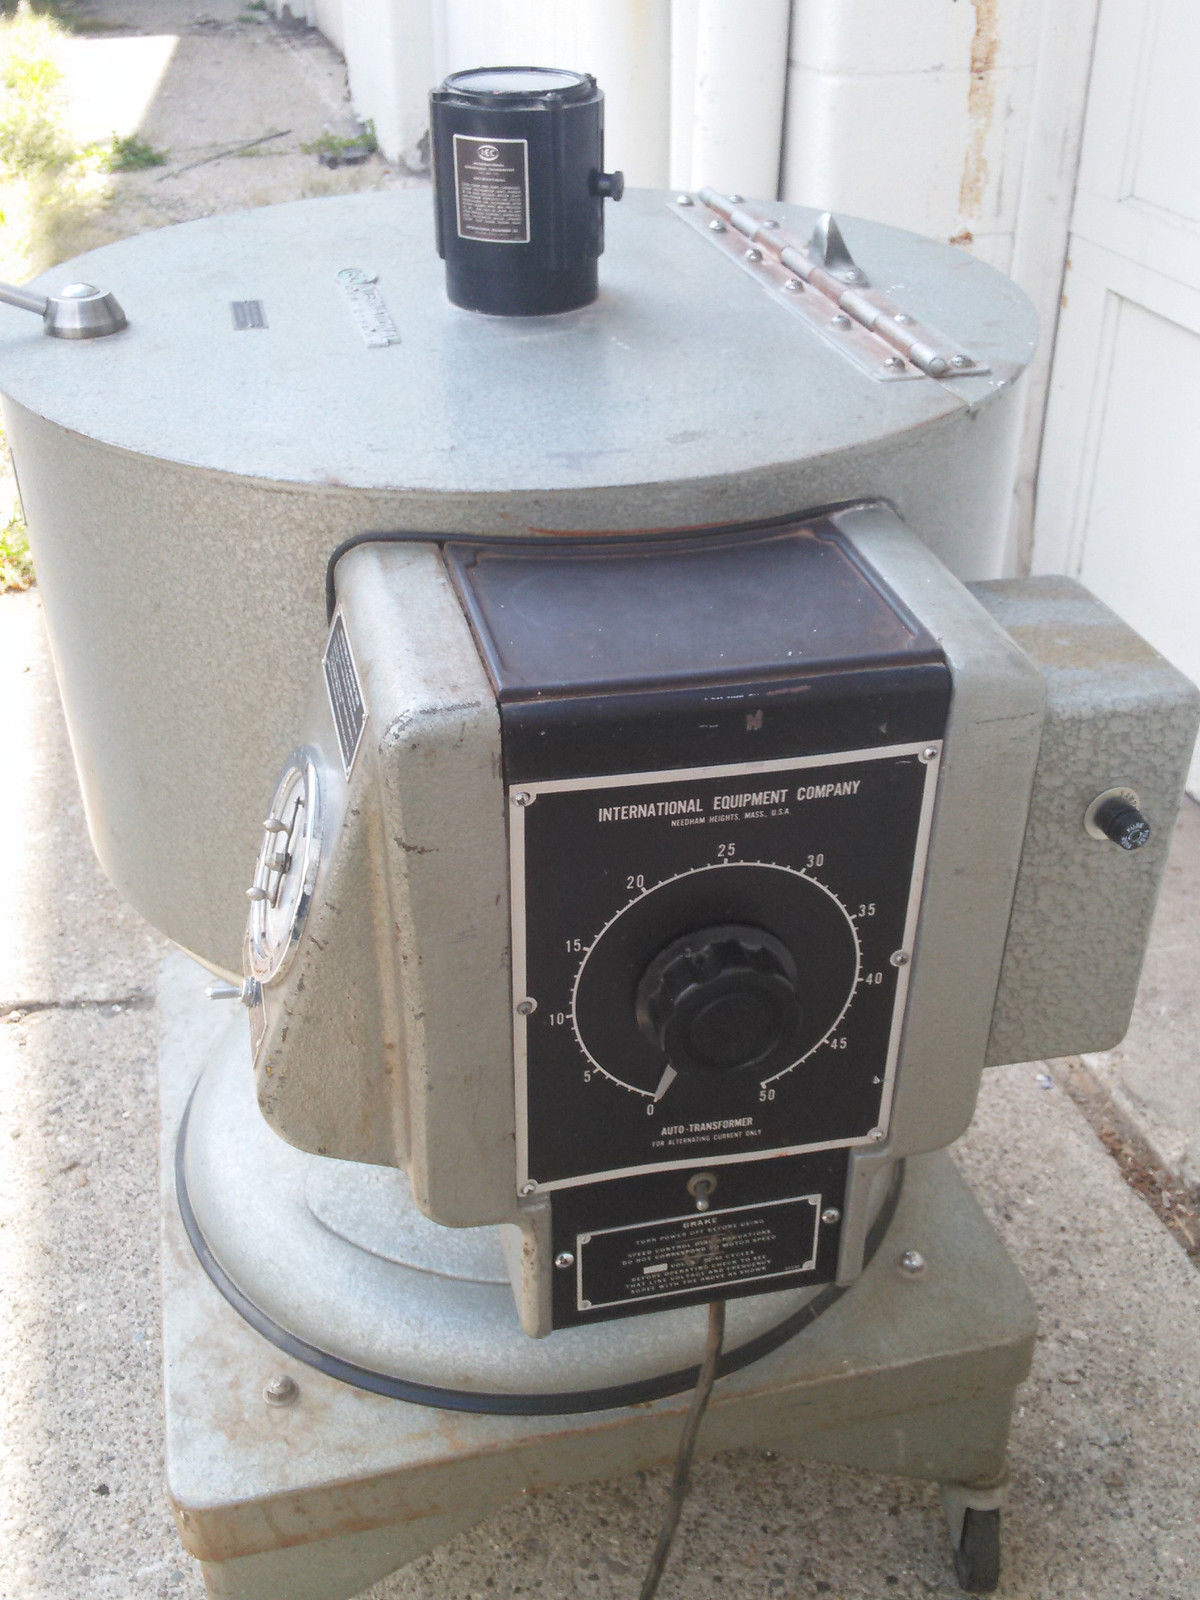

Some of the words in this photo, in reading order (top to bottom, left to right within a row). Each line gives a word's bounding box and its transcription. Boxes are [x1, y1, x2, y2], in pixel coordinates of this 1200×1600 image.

[598, 799, 703, 822] INTERNATIONAL
[713, 789, 788, 810] EQUIPMENT
[796, 780, 861, 801] COMPANY
[671, 817, 706, 827] NEEDHAM
[717, 843, 736, 856] 25
[806, 854, 824, 867] 30
[627, 875, 644, 888] 20
[858, 903, 876, 916] 35
[566, 939, 582, 952] 15
[865, 972, 883, 985] 40
[550, 1013, 564, 1025] 10
[830, 1037, 847, 1049] 45
[584, 1071, 591, 1082] 5
[759, 1089, 775, 1102] 50
[646, 1104, 654, 1116] 0
[661, 1117, 753, 1136] AUTO-TRANSFORMER
[668, 1135, 711, 1145] ALTERNATING
[713, 1131, 742, 1140] CURRENT
[745, 1129, 761, 1137] ONLY
[683, 1218, 718, 1229] BRAKE
[636, 1238, 657, 1246] TURN
[660, 1231, 687, 1241] POWER
[690, 1228, 704, 1236] OFF
[707, 1223, 737, 1233] BEFORE
[741, 1218, 765, 1228] USING
[628, 1249, 652, 1258] SPEED
[655, 1243, 691, 1254] CONTROL
[636, 1255, 651, 1263] NOT
[655, 1245, 707, 1260] CORRESPOND
[722, 1239, 750, 1248] MOTOR
[753, 1233, 777, 1243] SPEED
[725, 1249, 755, 1259] CYCLES
[625, 1279, 646, 1289] THAT
[649, 1277, 667, 1285] LINE
[670, 1271, 704, 1282] VOLTAGE
[727, 1259, 771, 1272] FREQUENCY
[631, 1273, 661, 1282] BEFORE
[664, 1264, 708, 1276] OPERATING
[711, 1259, 738, 1268] CHECK
[630, 1286, 655, 1295] AGREE
[683, 1277, 698, 1285] THE
[700, 1273, 725, 1281] ABOVE
[740, 1265, 767, 1276] SHOWN
